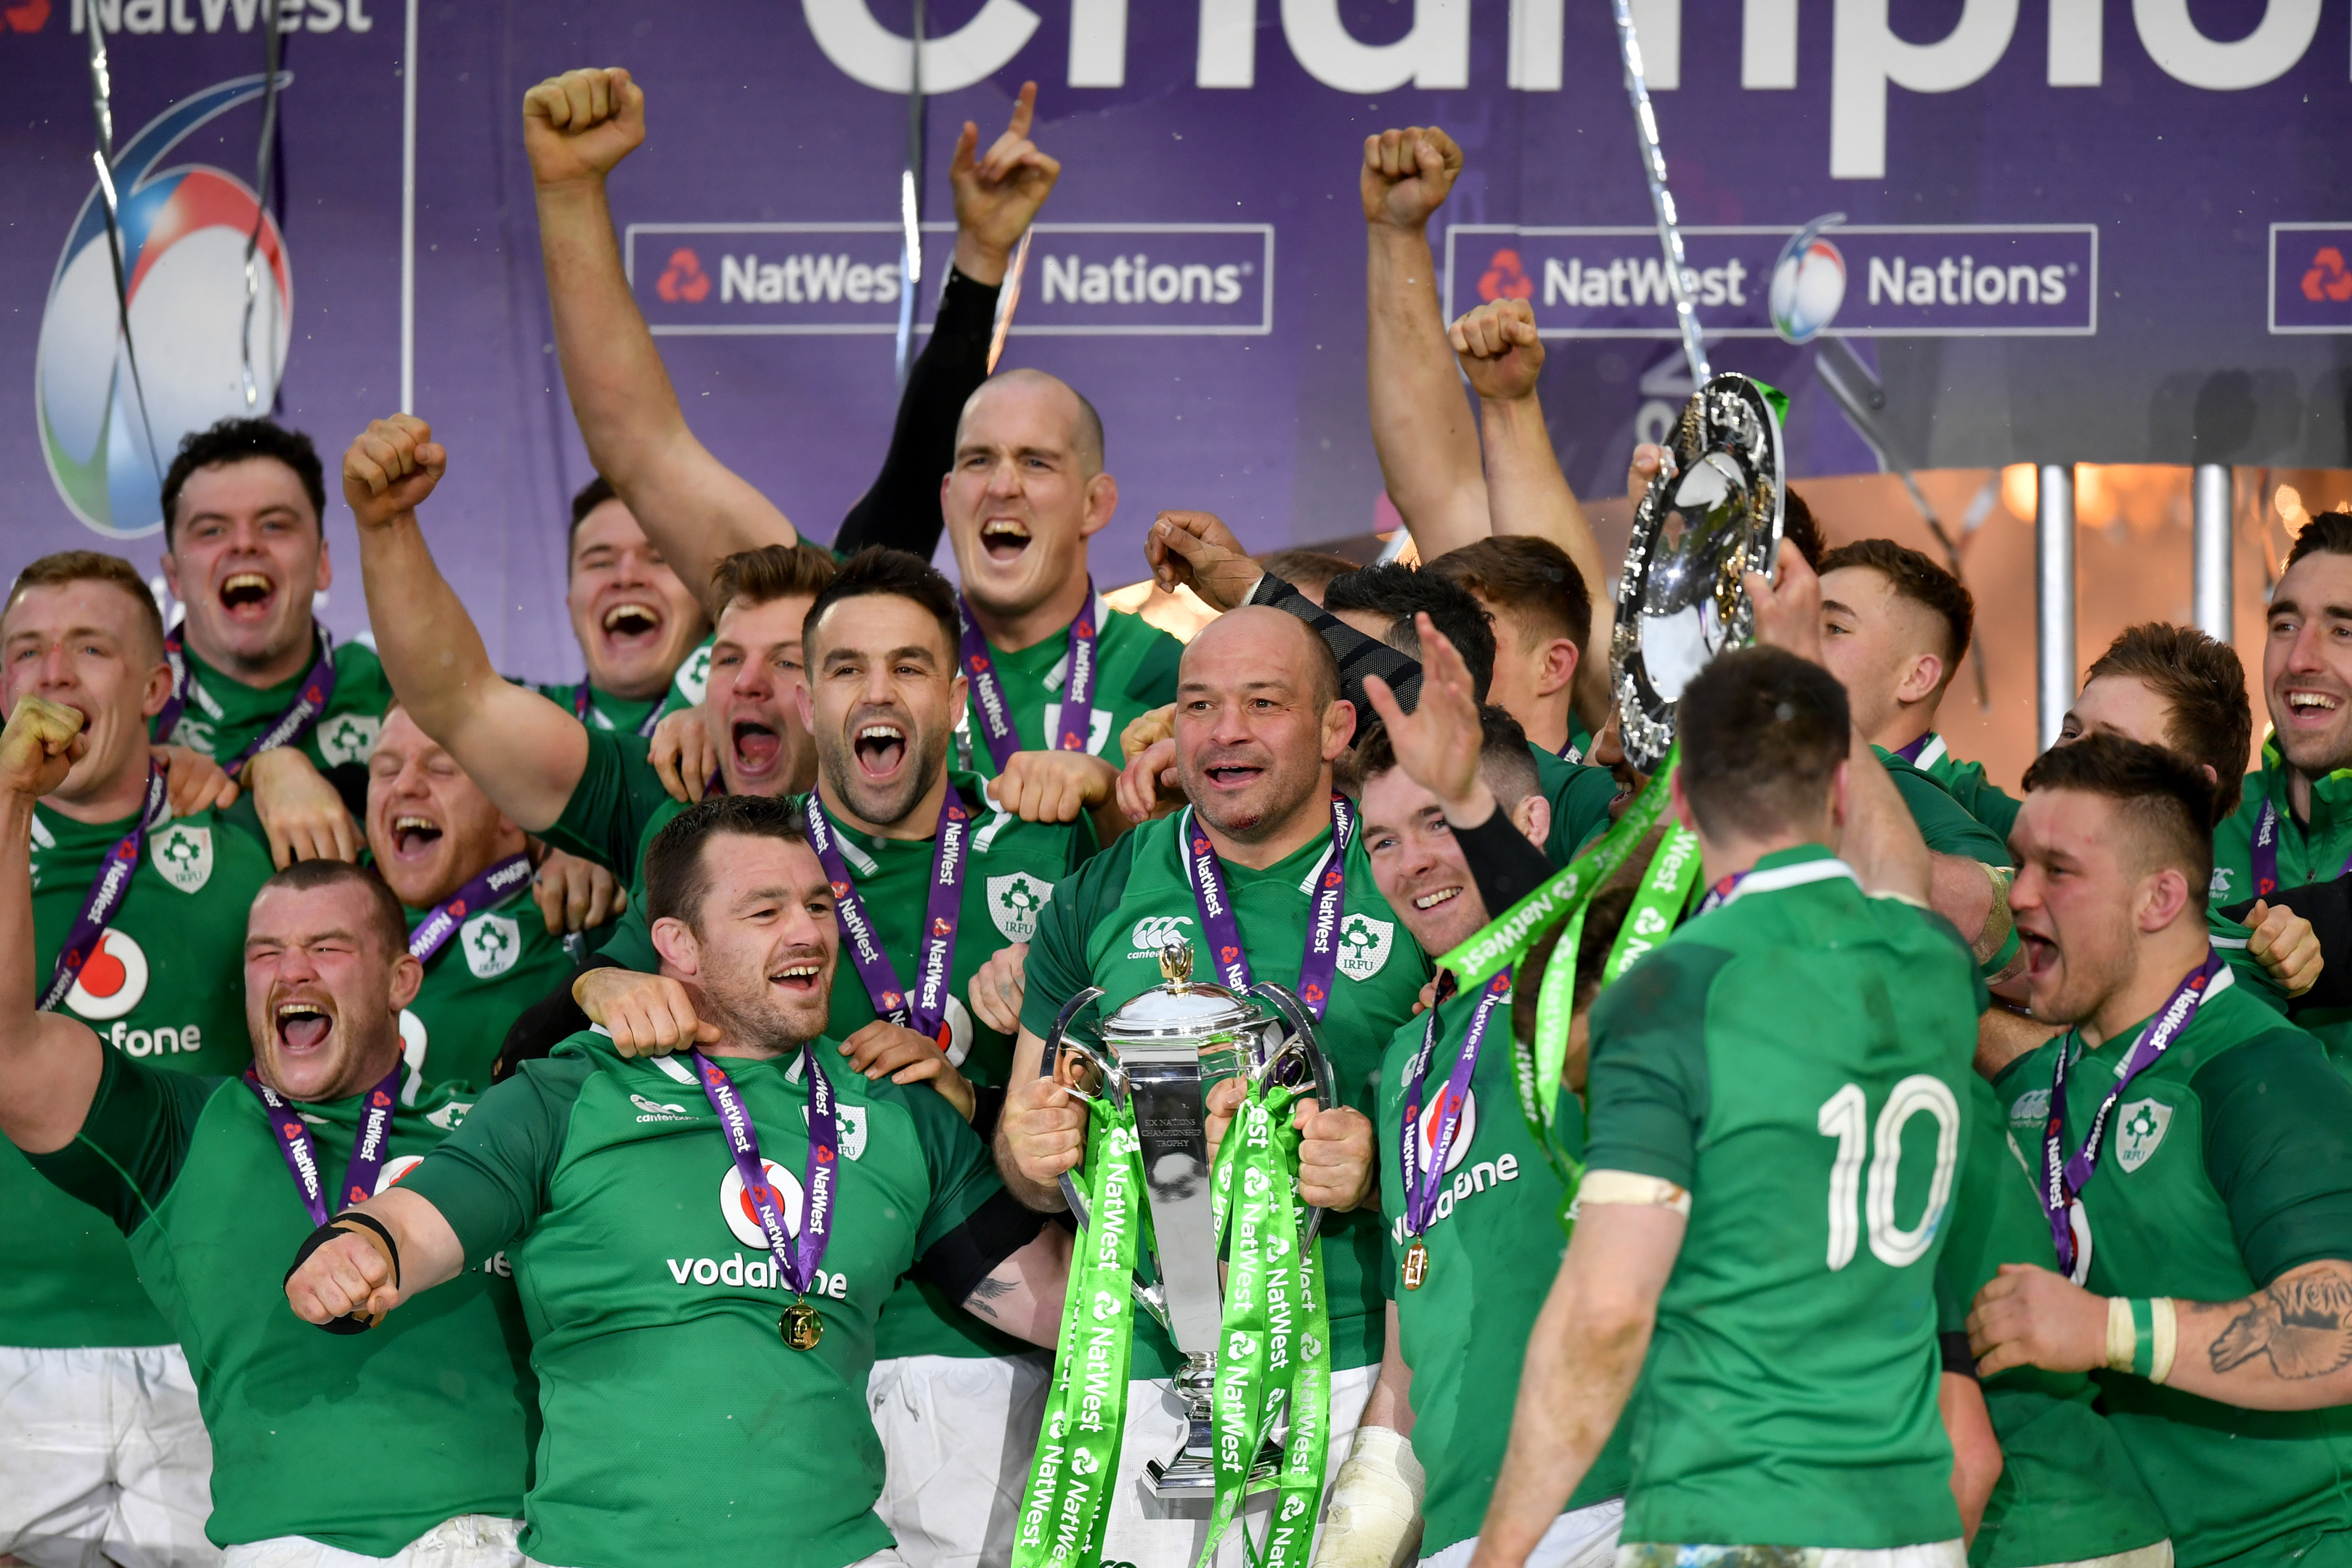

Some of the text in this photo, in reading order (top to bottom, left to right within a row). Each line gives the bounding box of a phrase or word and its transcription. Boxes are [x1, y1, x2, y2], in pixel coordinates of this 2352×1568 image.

[70, 0, 373, 34] NatWest
[720, 254, 1243, 303] NatWes Nations
[1868, 255, 2068, 304] Nations
[1070, 639, 1091, 704] NatWest
[975, 672, 1009, 739] NatWest
[807, 794, 829, 855] NatWest
[940, 821, 963, 886] NatWest
[86, 859, 129, 925] NatWest
[1195, 854, 1224, 918] NatWest
[838, 897, 879, 965] NatWest
[1004, 920, 1033, 936] IRFU
[1314, 890, 1338, 954] NatWest
[1458, 892, 1554, 976] NatWest
[921, 939, 947, 1010] NatWest
[1343, 958, 1374, 971] IRFU
[101, 1021, 203, 1058] fone
[1462, 992, 1499, 1061] NatWest
[2149, 987, 2200, 1051] NatWest
[359, 1107, 386, 1162] NatWest
[714, 1085, 752, 1153] NatWest
[841, 1145, 856, 1156] FU
[1160, 1118, 1196, 1127] NATIONS
[1403, 1122, 1417, 1193] NatWest
[1818, 1074, 1961, 1272] 10
[2046, 1137, 2064, 1212] NatWest
[809, 1166, 831, 1236] NatWest
[1097, 1162, 1131, 1273] NatWest
[666, 1251, 848, 1299] vodafne
[1233, 1202, 1263, 1312] NatWest
[1266, 1267, 1293, 1373] NatWest
[1078, 1326, 1115, 1434] NatWest
[1221, 1366, 1250, 1474] NatWest
[1291, 1368, 1319, 1476] NatWest
[1020, 1444, 1065, 1548] NatWest
